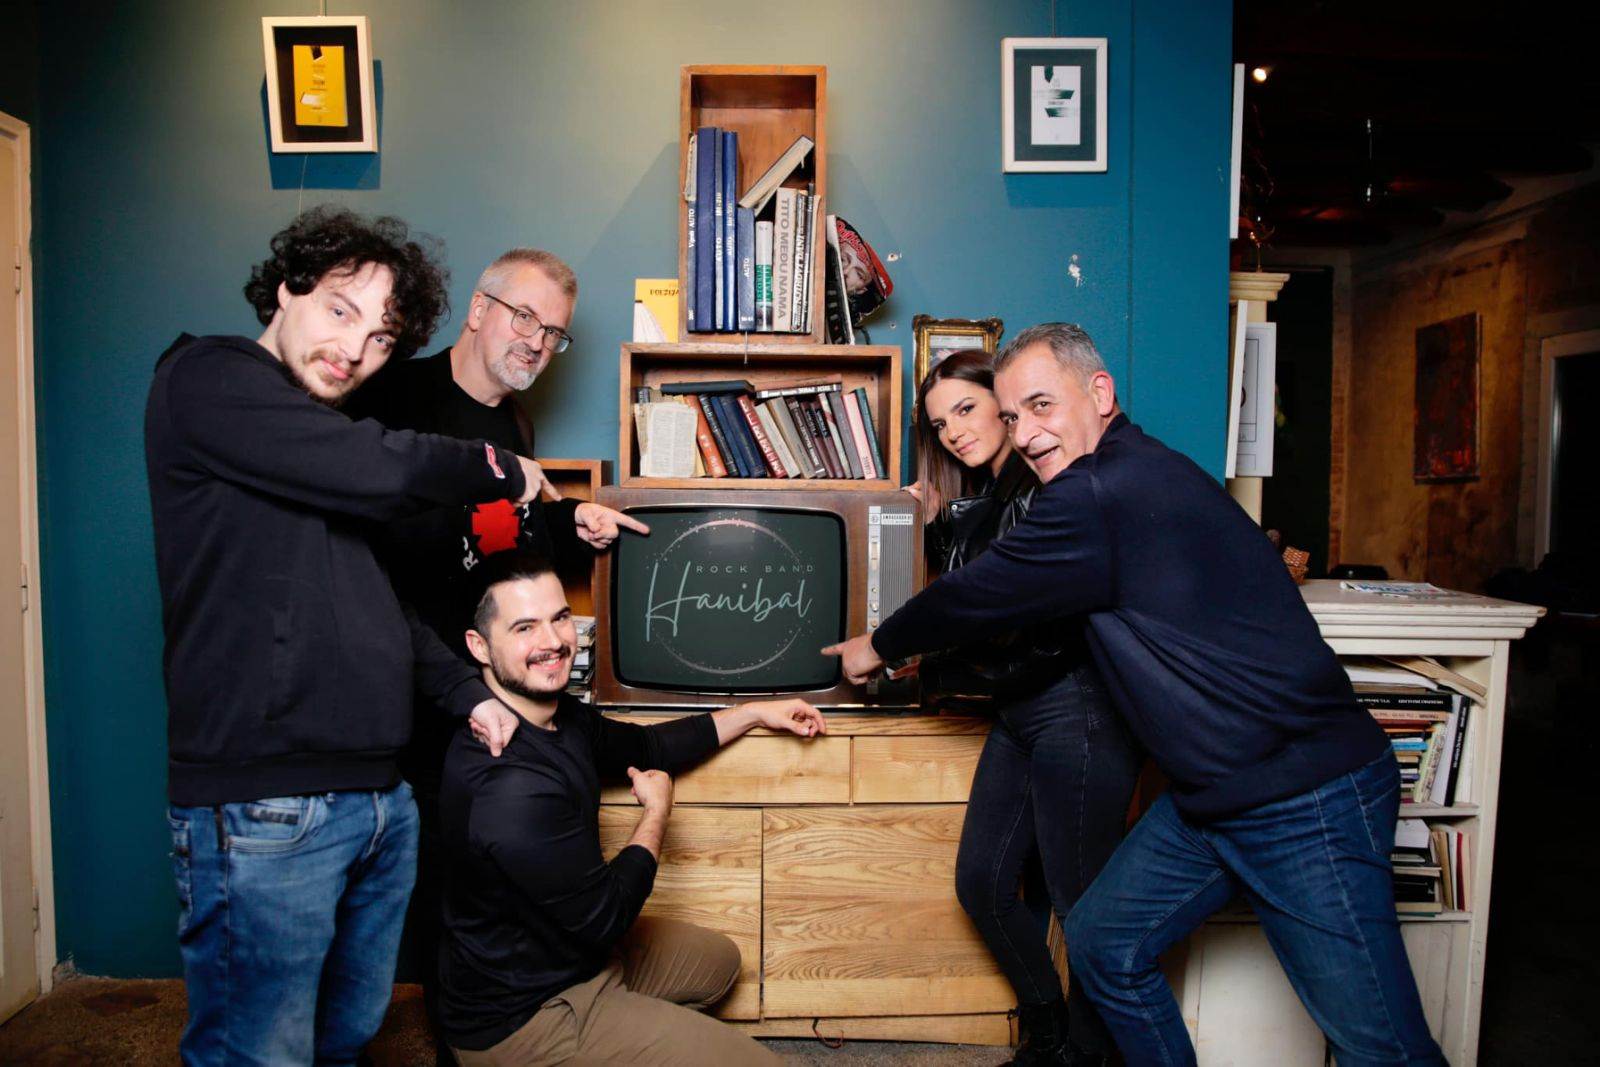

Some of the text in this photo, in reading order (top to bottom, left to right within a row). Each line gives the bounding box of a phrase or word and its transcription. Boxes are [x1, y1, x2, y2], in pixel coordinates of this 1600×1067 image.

[688, 208, 696, 228] AUTO
[780, 198, 790, 230] TITO
[796, 234, 805, 262] DANI
[743, 257, 751, 278] AUTO
[777, 276, 788, 320] NAMA
[696, 565, 815, 574] ROCK BAND
[645, 560, 812, 643] Hanibal
